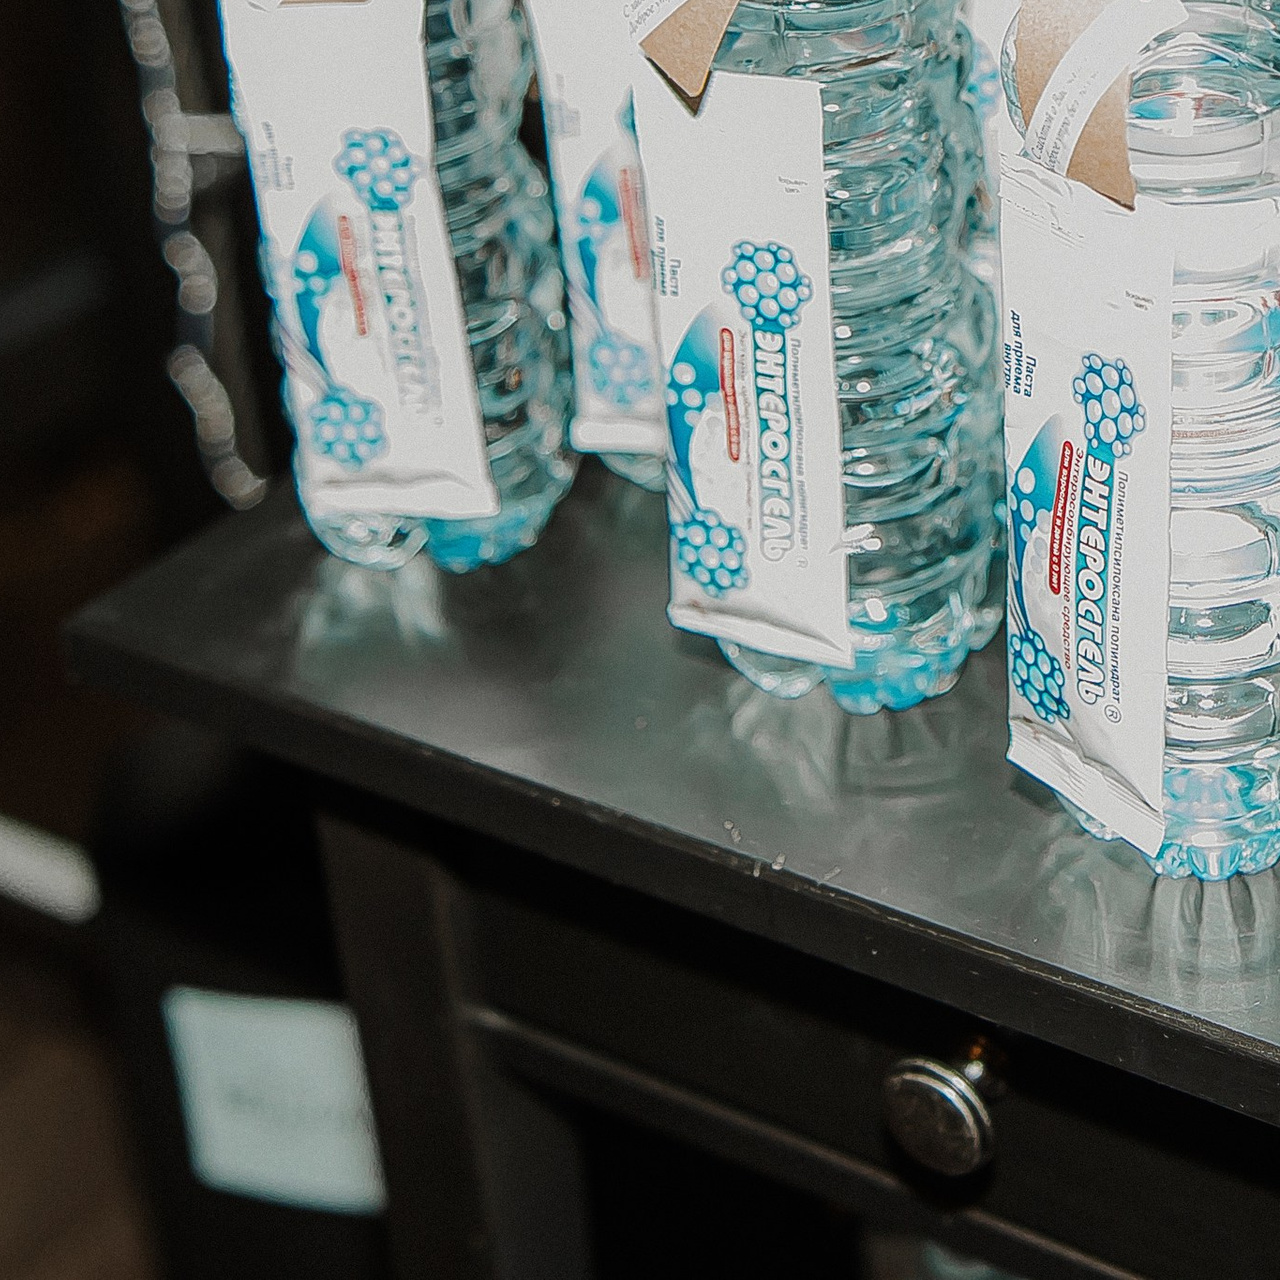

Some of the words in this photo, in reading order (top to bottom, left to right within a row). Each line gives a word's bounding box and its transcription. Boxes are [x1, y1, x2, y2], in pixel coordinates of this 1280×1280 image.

[1010, 310, 1021, 338] для
[1013, 340, 1023, 394] приема
[1024, 355, 1037, 397] Паста
[754, 330, 795, 562] ЭНТЕРОСГЕЛЬ
[1063, 447, 1071, 467] для
[1056, 468, 1068, 516] взрослых
[1052, 527, 1060, 556] детей
[1063, 447, 1084, 602] Энтеросорбирующее
[1111, 471, 1128, 621] Полиметилсилоксана
[1076, 454, 1111, 705] ЭНТЕРОСГЕЛЬ
[1062, 605, 1071, 670] средство
[1110, 625, 1121, 703] полигидрат
